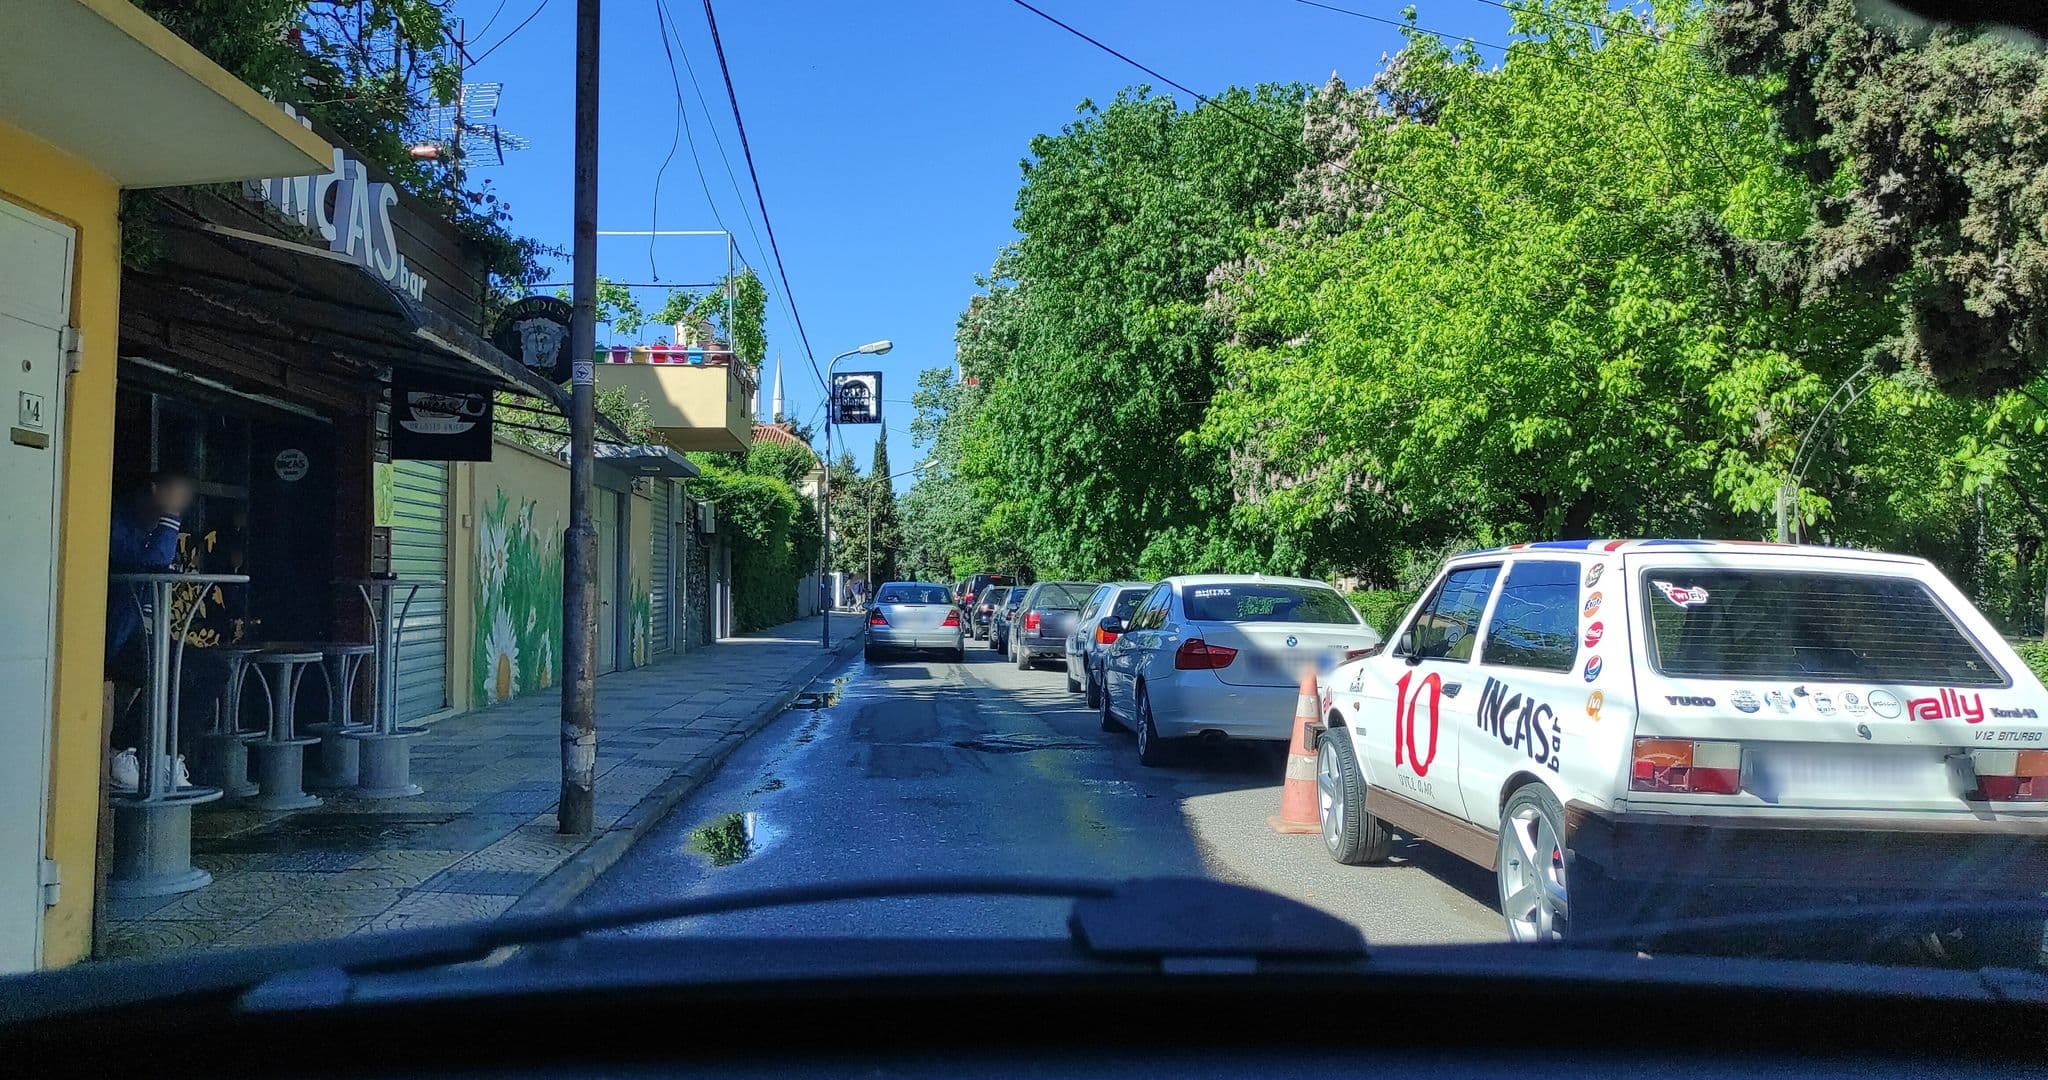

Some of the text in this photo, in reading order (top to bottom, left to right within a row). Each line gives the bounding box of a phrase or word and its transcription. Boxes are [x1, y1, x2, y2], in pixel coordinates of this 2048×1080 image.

[400, 254, 428, 302] bar
[26, 399, 40, 421] 14
[1477, 676, 1553, 764] INCAS
[1664, 695, 1716, 707] YUGO
[1906, 687, 1984, 724] rally
[1395, 670, 1441, 777] 10
[1547, 716, 1561, 773] bar
[1974, 730, 2043, 742] V12 BITURBO
